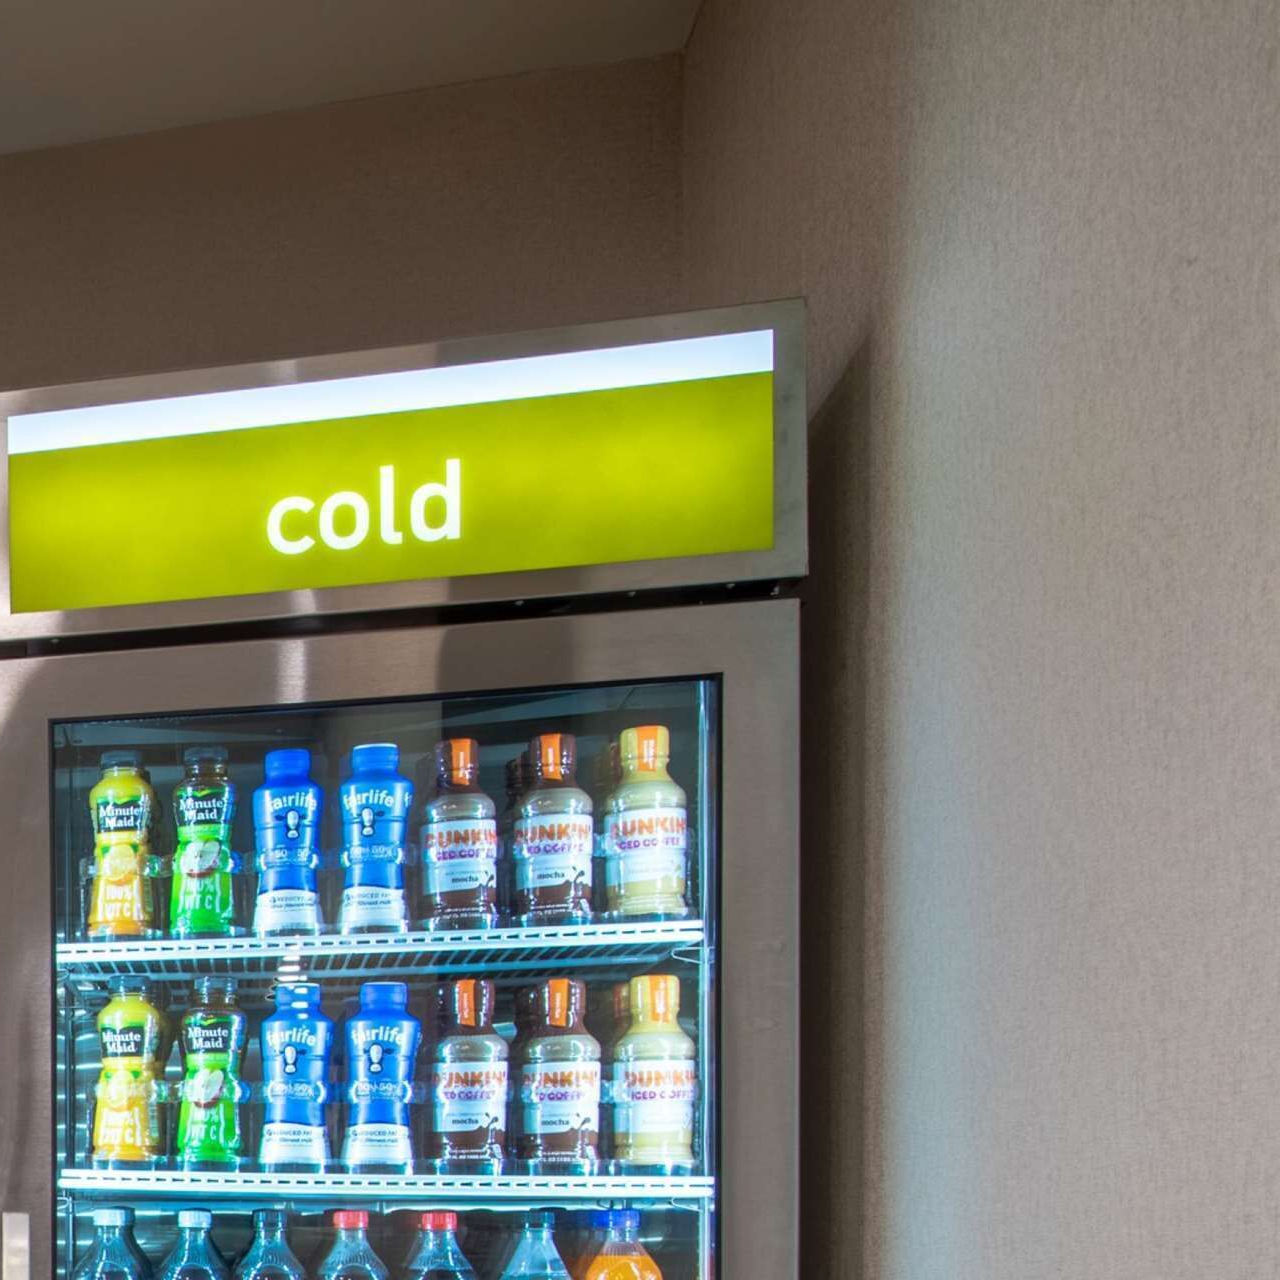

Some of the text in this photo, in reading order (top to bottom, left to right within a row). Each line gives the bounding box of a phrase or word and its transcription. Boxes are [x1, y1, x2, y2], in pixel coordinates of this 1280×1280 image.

[265, 458, 462, 555] cold
[179, 797, 224, 810] Minute
[99, 805, 142, 817] Minute
[185, 808, 218, 822] Maid
[104, 816, 135, 828] Maid
[451, 874, 479, 884] mocha
[537, 871, 565, 880] mocha
[187, 1026, 229, 1040] Minute
[193, 1038, 223, 1050] Maid
[452, 1117, 479, 1126] mocha
[541, 1118, 570, 1126] mocha
